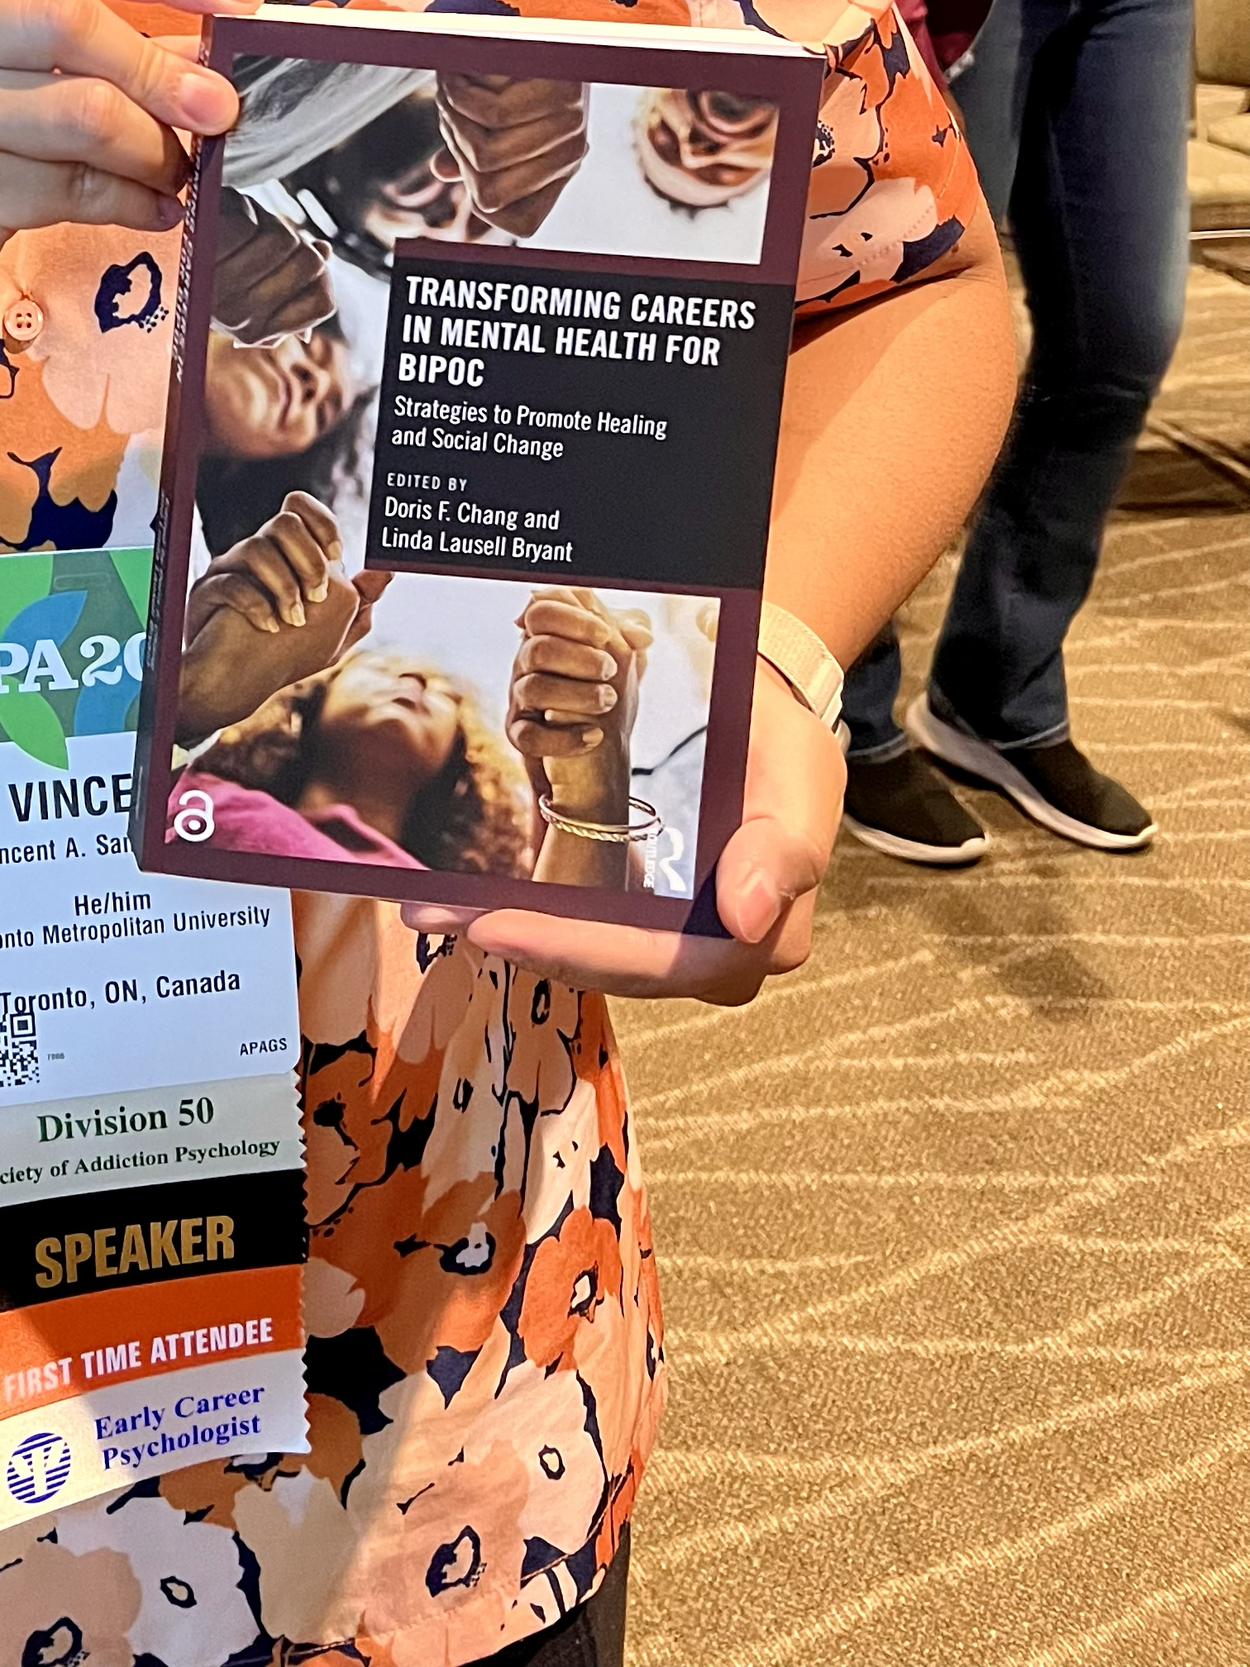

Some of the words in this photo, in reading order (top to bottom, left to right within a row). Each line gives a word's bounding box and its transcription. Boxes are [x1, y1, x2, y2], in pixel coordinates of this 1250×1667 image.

[405, 275, 622, 321] TRANSFORMING
[630, 293, 757, 330] CAREERS
[402, 314, 432, 345] IN
[440, 317, 546, 353] MENTAL
[555, 326, 657, 362] HEALTH
[665, 334, 721, 366] FOR
[398, 352, 485, 387] BIPOC
[394, 395, 488, 425] Strategies
[494, 404, 512, 425] to
[516, 405, 592, 431] Promote
[597, 411, 668, 441] Healing
[391, 427, 427, 447] and
[431, 428, 488, 452] Social
[493, 432, 564, 461] Change
[387, 472, 441, 490] EDITED
[448, 477, 467, 491] BY
[384, 496, 432, 520] Doris
[438, 500, 451, 522] F.
[457, 502, 519, 531] Chang
[523, 510, 560, 530] and
[382, 526, 433, 551] Linda
[439, 531, 507, 556] Lausell
[512, 537, 573, 563] Bryant
[8, 773, 132, 822] VINCE
[65, 837, 86, 858] A.
[74, 891, 151, 916] He/him
[42, 917, 165, 945] Metropolitan
[173, 905, 271, 931] University
[105, 979, 147, 1004] ON,
[156, 970, 241, 998] Canada
[239, 1037, 288, 1056] APAGS
[37, 1104, 168, 1143] Division
[178, 1096, 215, 1126] 50
[49, 1159, 70, 1178] of
[74, 1148, 169, 1175] Addiction
[174, 1139, 281, 1165] Psychology
[34, 1215, 235, 1290] SPEAKER
[3, 1357, 73, 1404] FIRST
[80, 1341, 142, 1380] TIME
[150, 1317, 274, 1365] ATTENDEE
[95, 1403, 166, 1441] Early
[174, 1385, 266, 1419] Career
[101, 1414, 262, 1472] Psychologist
